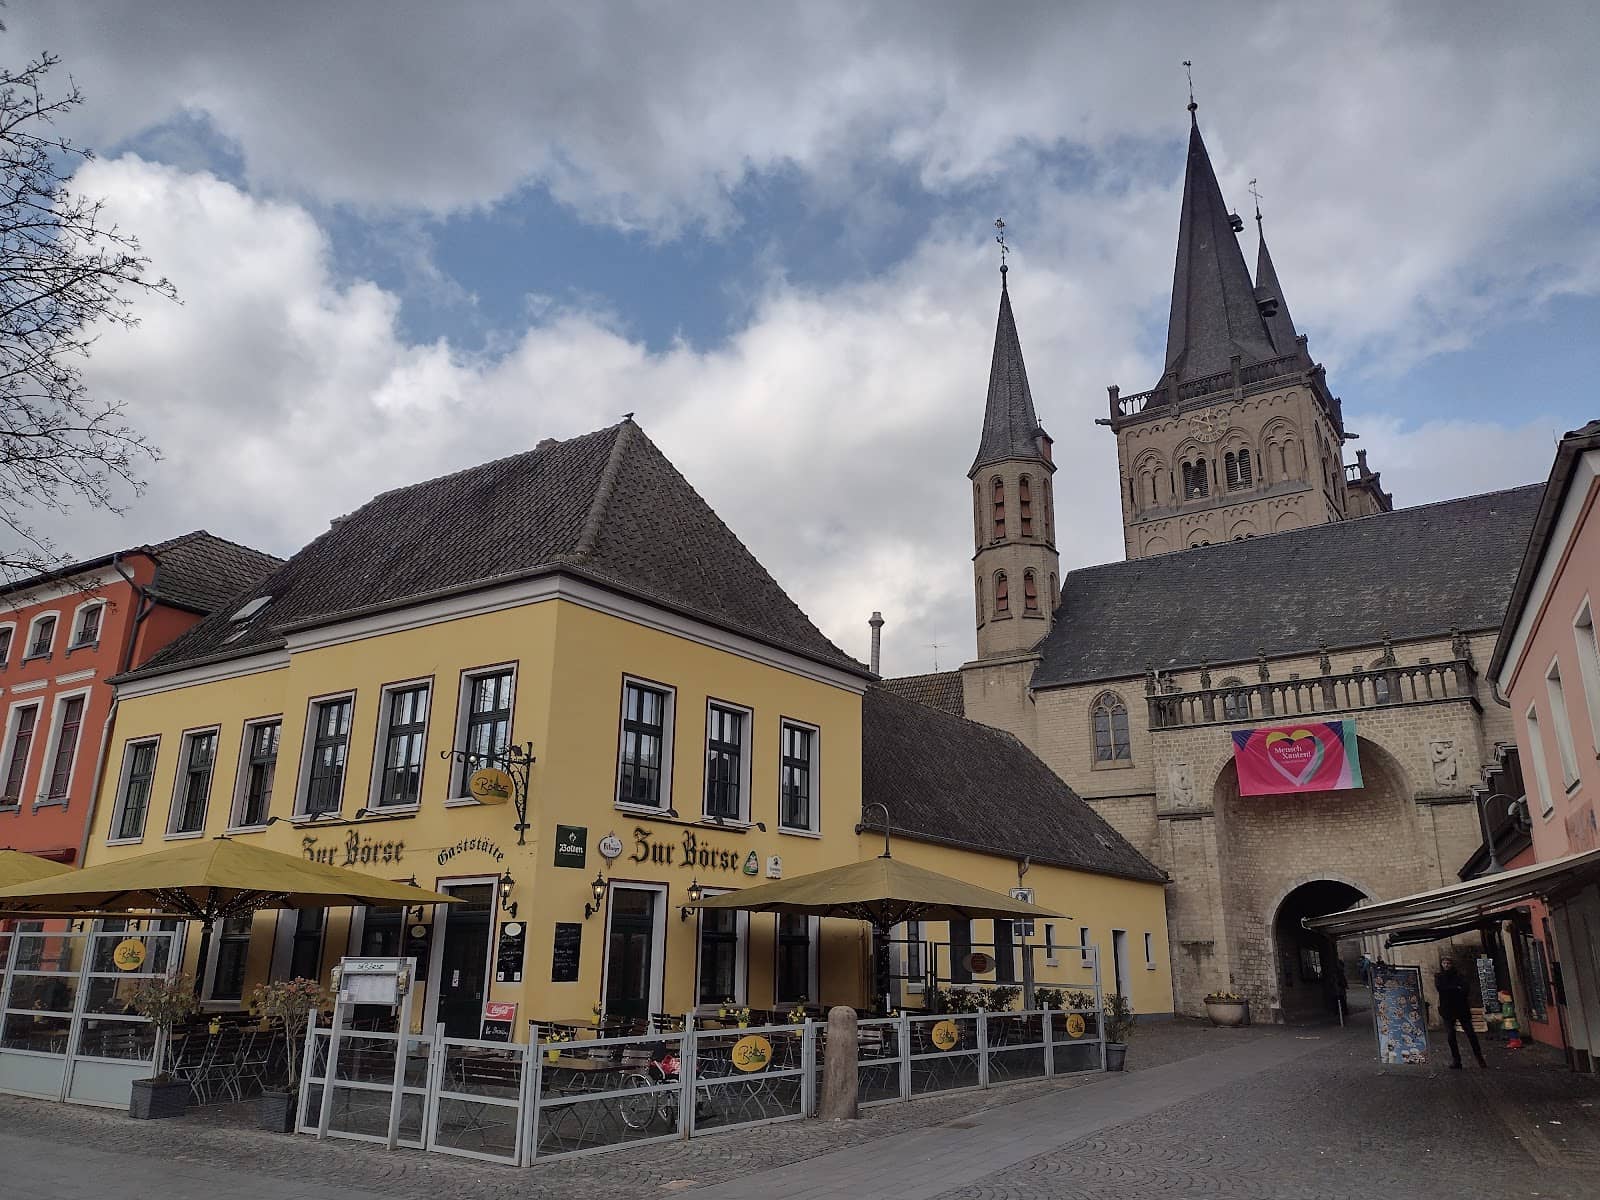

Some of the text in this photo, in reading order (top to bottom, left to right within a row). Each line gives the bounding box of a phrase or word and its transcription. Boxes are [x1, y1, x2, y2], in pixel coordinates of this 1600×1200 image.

[1274, 744, 1303, 754] Mensch
[1282, 751, 1312, 760] Xanten!
[302, 829, 405, 867] Zur Börse
[437, 836, 504, 866] Gaststätte
[559, 843, 584, 854] Bolten
[628, 826, 739, 871] Zur Börse
